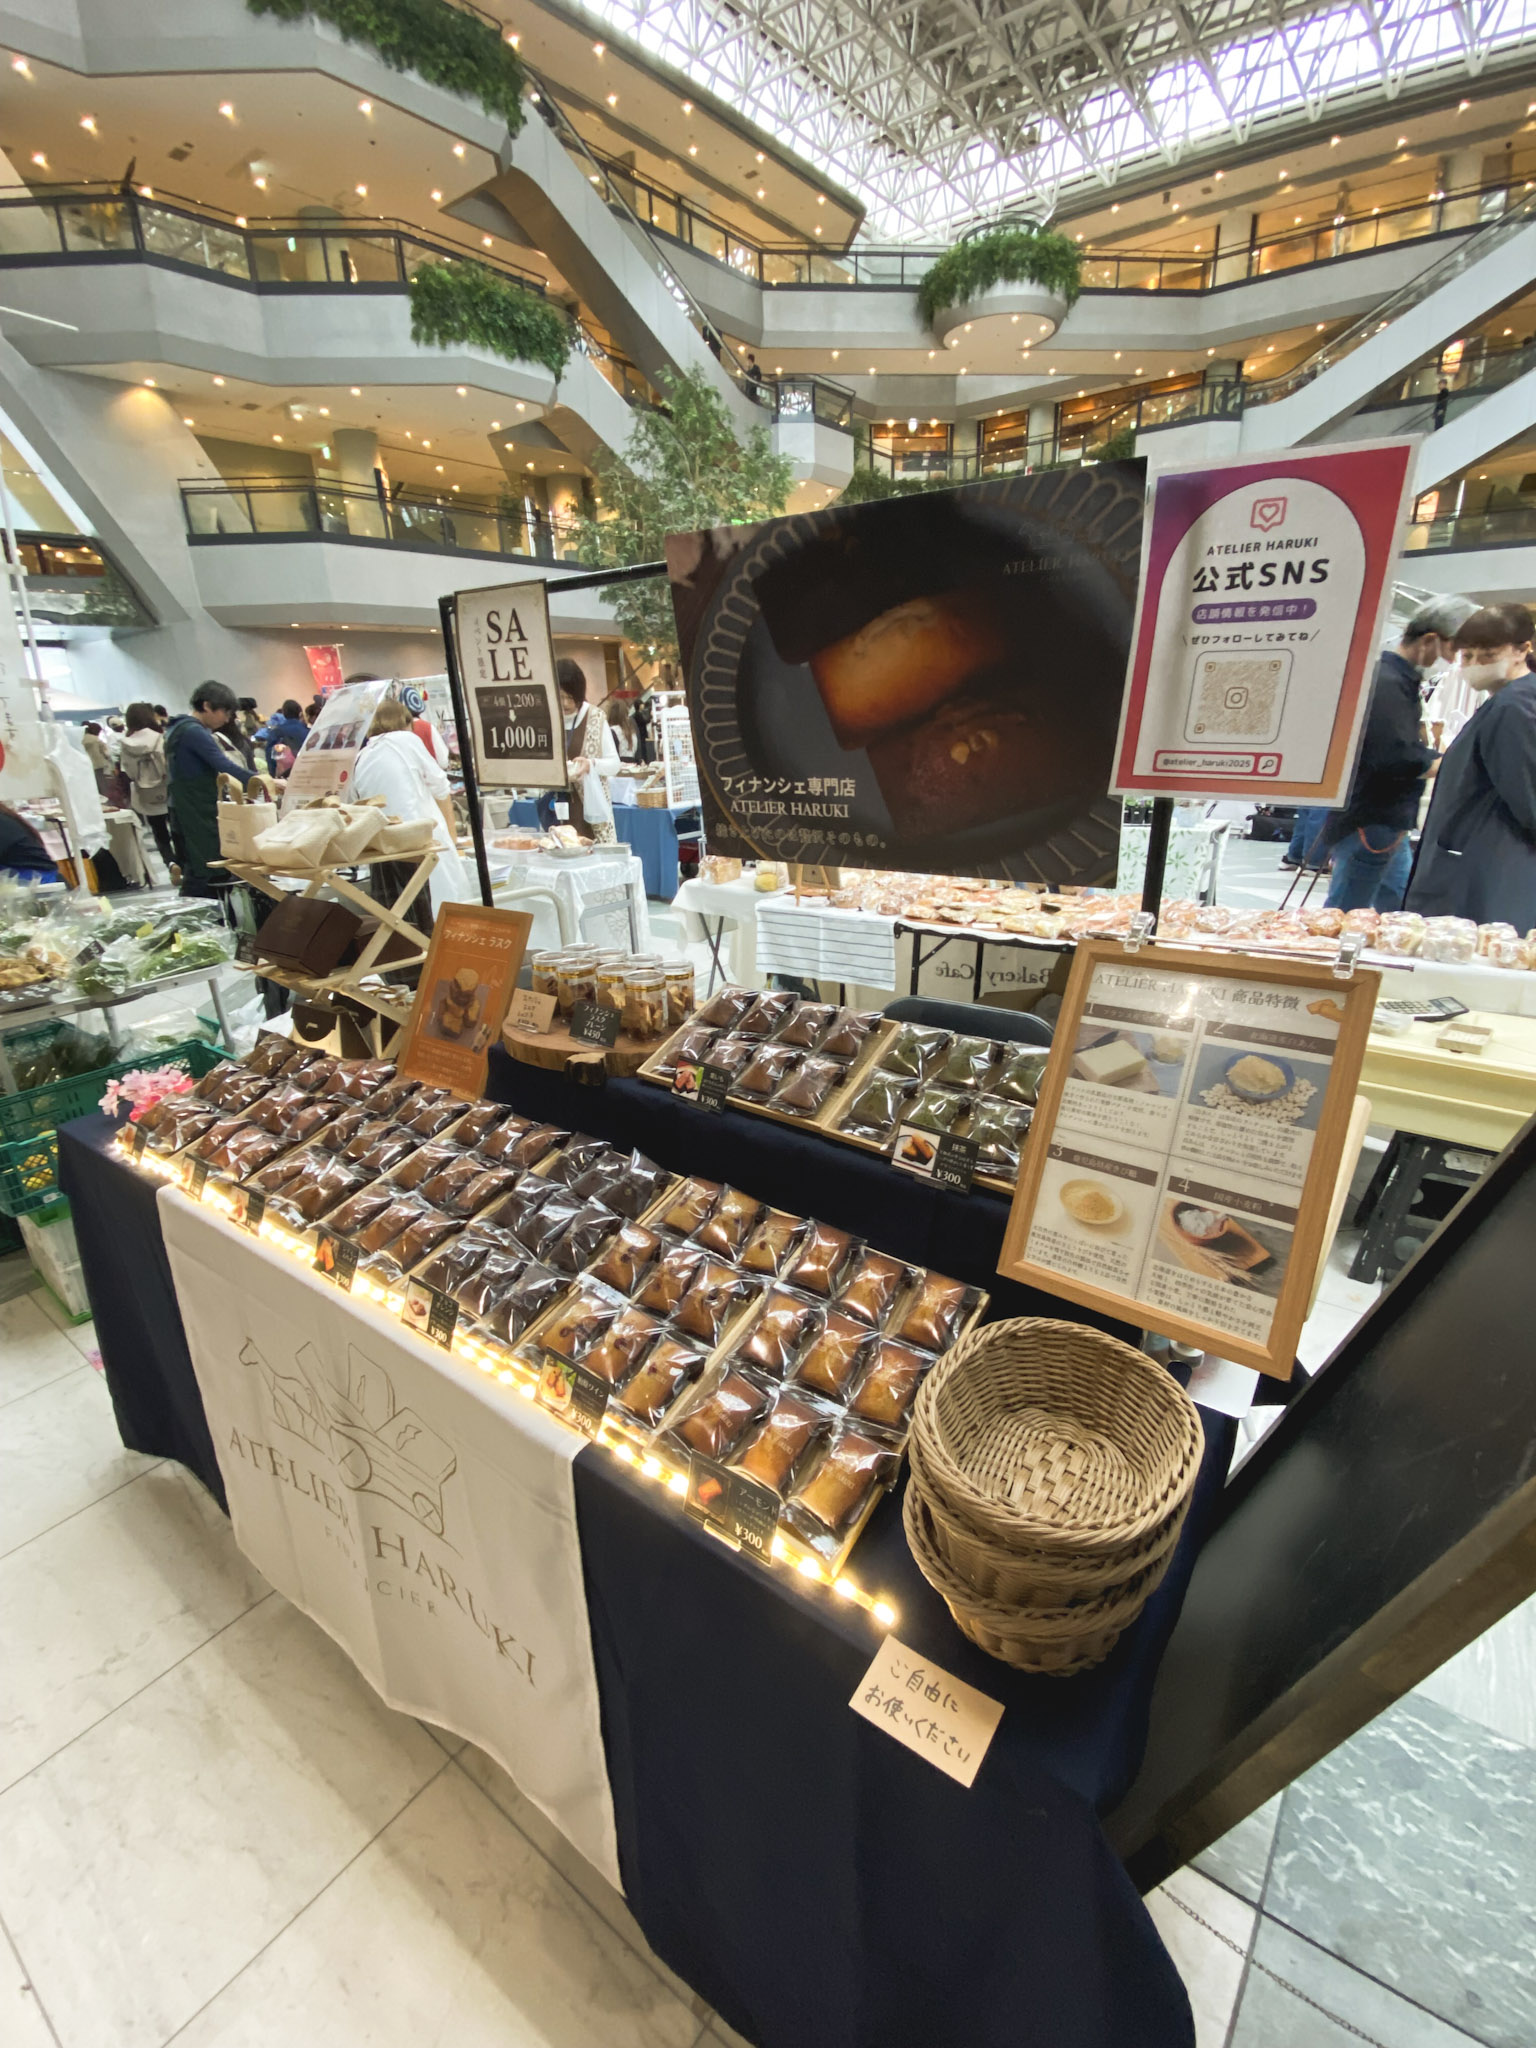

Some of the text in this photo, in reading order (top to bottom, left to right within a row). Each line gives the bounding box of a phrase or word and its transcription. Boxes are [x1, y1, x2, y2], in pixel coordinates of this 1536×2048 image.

[1207, 537, 1319, 557] ATELIER HARUKI
[1191, 558, 1330, 593] 公式SNS
[1192, 632, 1309, 645] ぜひフォローしてみてね
[1163, 757, 1251, 768] @atelier_haruki2025
[720, 776, 856, 797] フィナンシェ専門店
[730, 800, 850, 818] ATELIER HARUKI
[443, 929, 512, 950] フィナンシェ ラスク
[1094, 973, 1159, 992] ATELIER
[1232, 988, 1300, 1011] 商品特徴
[936, 1168, 962, 1185] ¥300
[571, 1407, 592, 1430] ¥300
[739, 1487, 778, 1516] アーモンド
[735, 1522, 763, 1549] ¥300
[371, 1526, 538, 1690] HARUKI
[890, 1658, 959, 1713] ご自由に
[864, 1684, 971, 1763] お使いください
